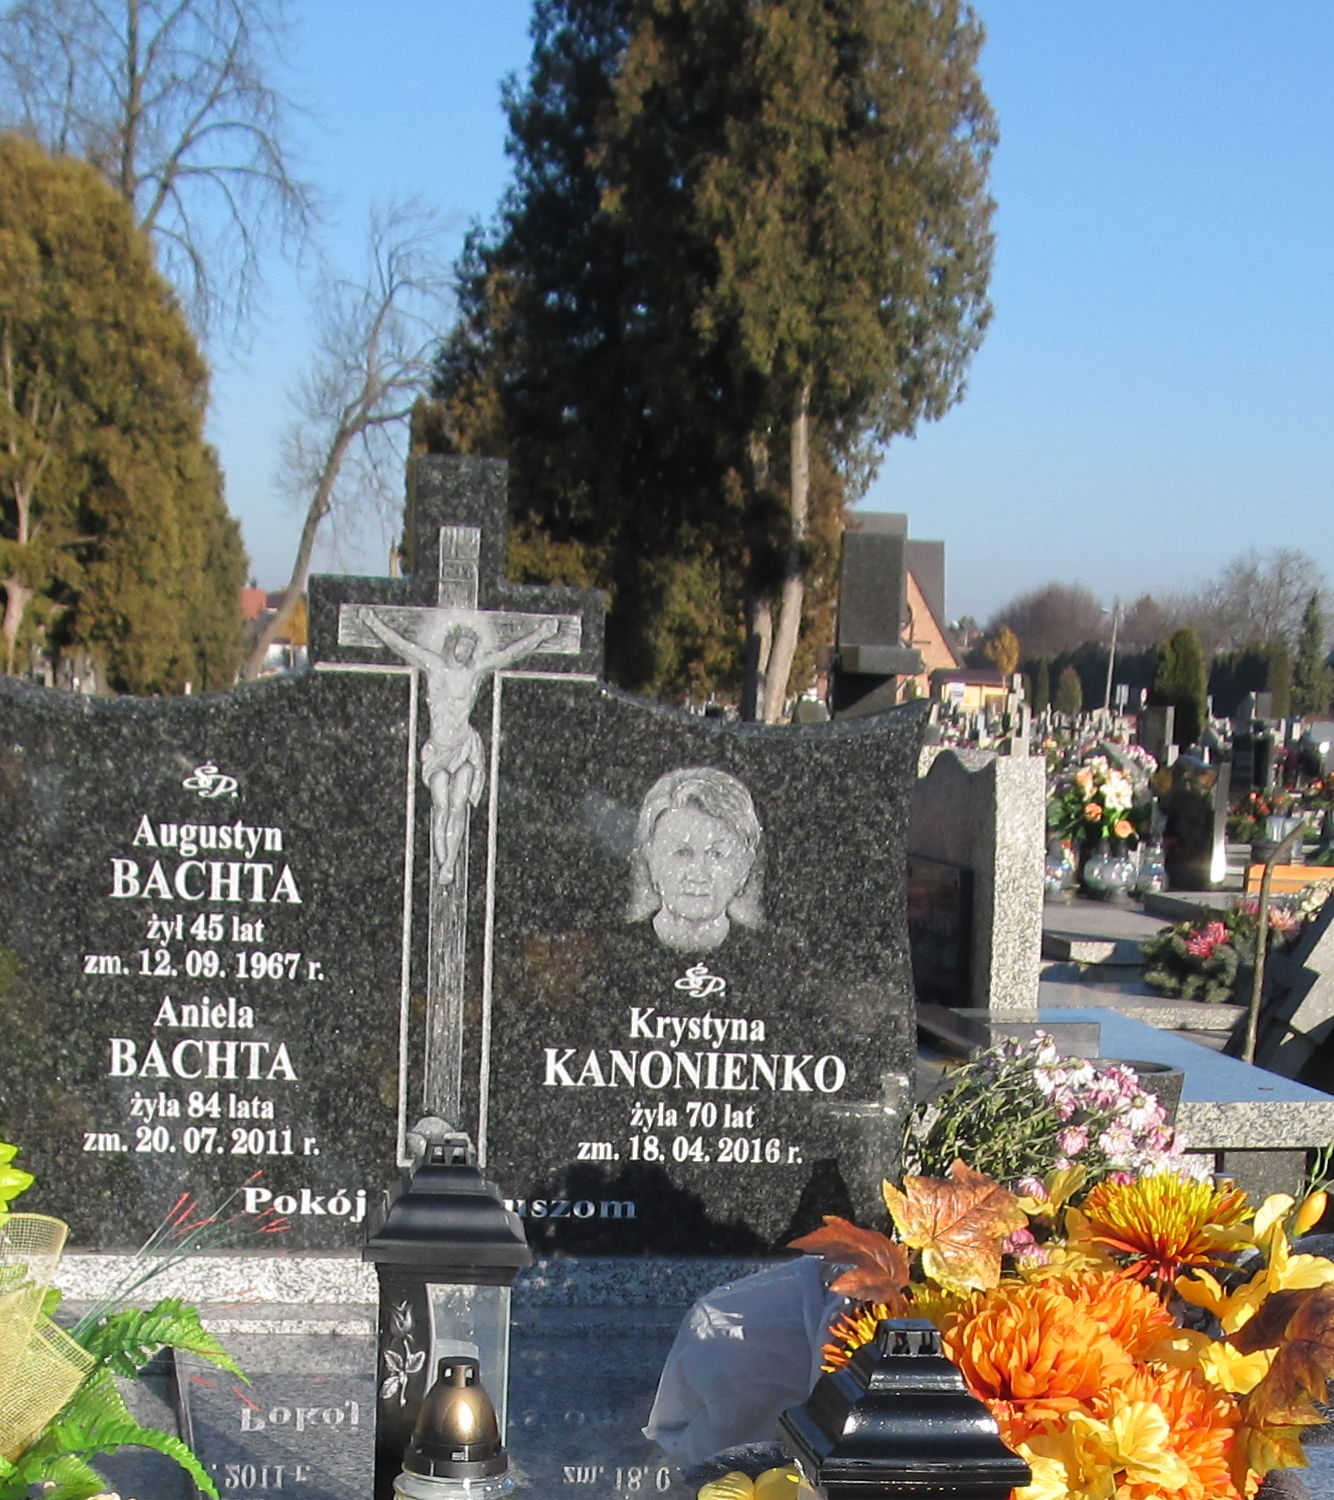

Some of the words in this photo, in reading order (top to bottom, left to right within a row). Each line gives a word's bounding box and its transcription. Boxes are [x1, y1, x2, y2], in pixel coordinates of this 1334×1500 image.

[132, 814, 283, 857] Augustyn
[109, 857, 303, 904] BACHTA
[146, 913, 184, 947] żył
[190, 914, 224, 942] 45
[231, 915, 265, 943] lat
[83, 953, 130, 976] zm.
[138, 948, 178, 977] 12.
[185, 949, 226, 979] 09.
[235, 951, 302, 981] 1967
[307, 960, 325, 981] r.
[153, 995, 255, 1030] Aniela
[628, 1006, 766, 1048] Krystyna
[108, 1037, 299, 1082] BACHTA
[542, 1047, 847, 1094] KANONIENKO
[130, 1091, 181, 1123] żyła
[187, 1091, 221, 1119] 84
[229, 1093, 275, 1120] lata
[630, 1102, 677, 1133] żyła
[685, 1101, 718, 1129] 70
[723, 1103, 756, 1129] lat
[82, 1131, 128, 1153] zm.
[135, 1125, 176, 1154] 20.
[183, 1127, 223, 1155] 07.
[231, 1128, 294, 1156] 2011
[303, 1137, 320, 1156] r.
[576, 1140, 621, 1161] zm.
[629, 1135, 666, 1162] 18.
[671, 1136, 711, 1163] 04.
[718, 1137, 781, 1164] 2016
[786, 1146, 803, 1165] r.
[242, 1187, 367, 1223] Pokój
